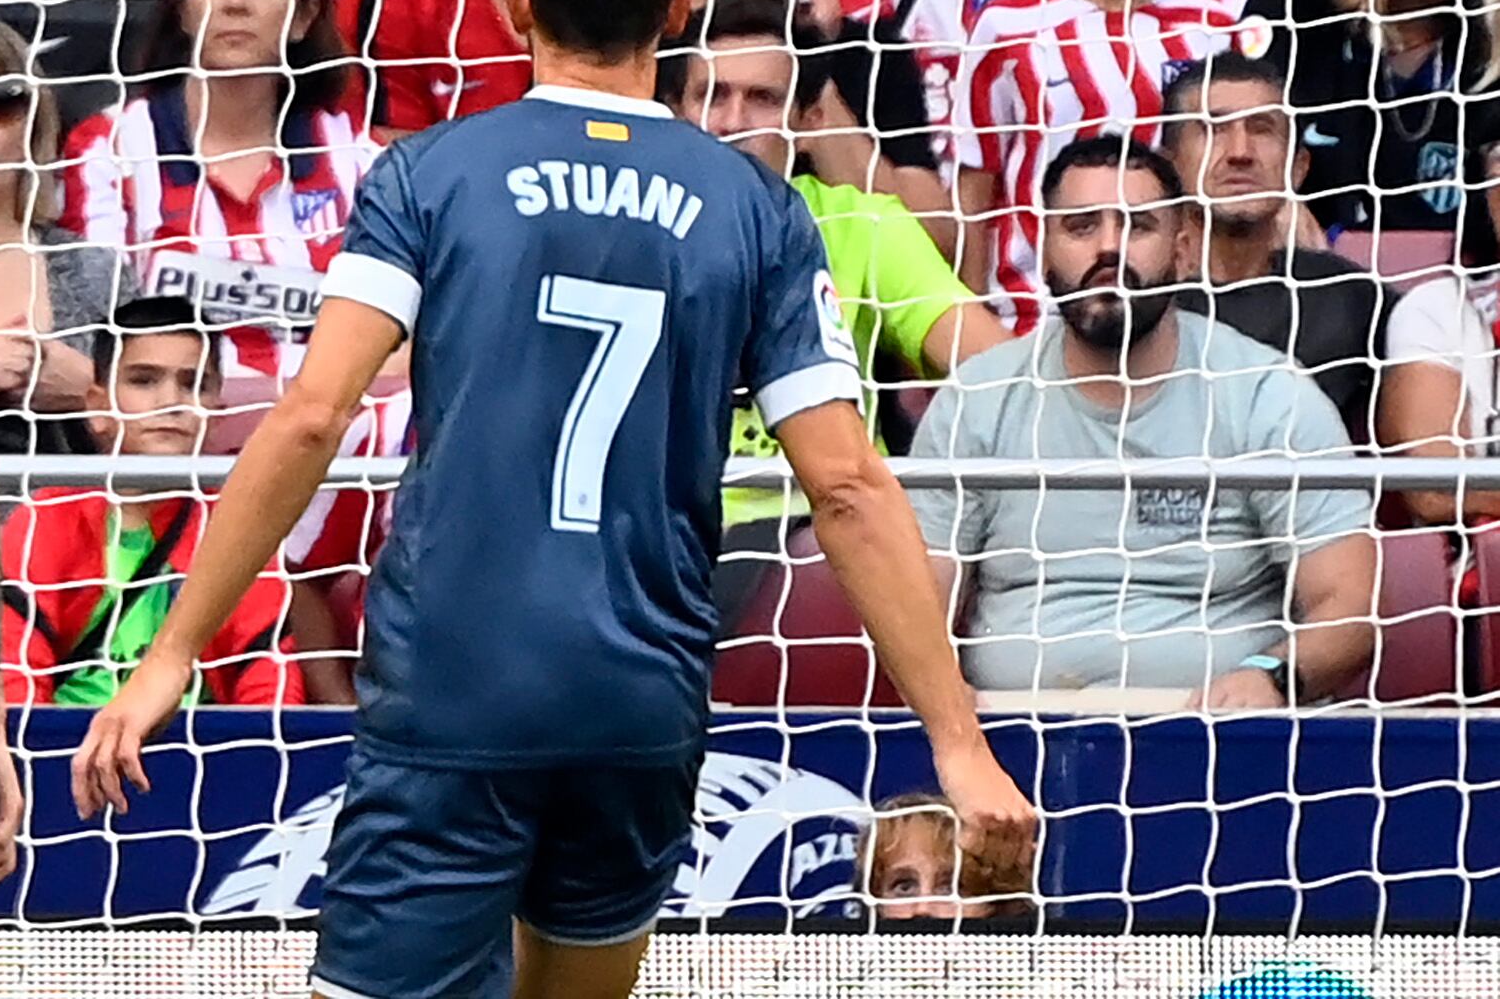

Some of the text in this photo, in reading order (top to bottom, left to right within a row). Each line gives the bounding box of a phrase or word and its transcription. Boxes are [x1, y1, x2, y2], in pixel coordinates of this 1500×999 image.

[507, 160, 703, 240] STUANI
[537, 274, 667, 533] 7
[789, 833, 858, 893] AZE
